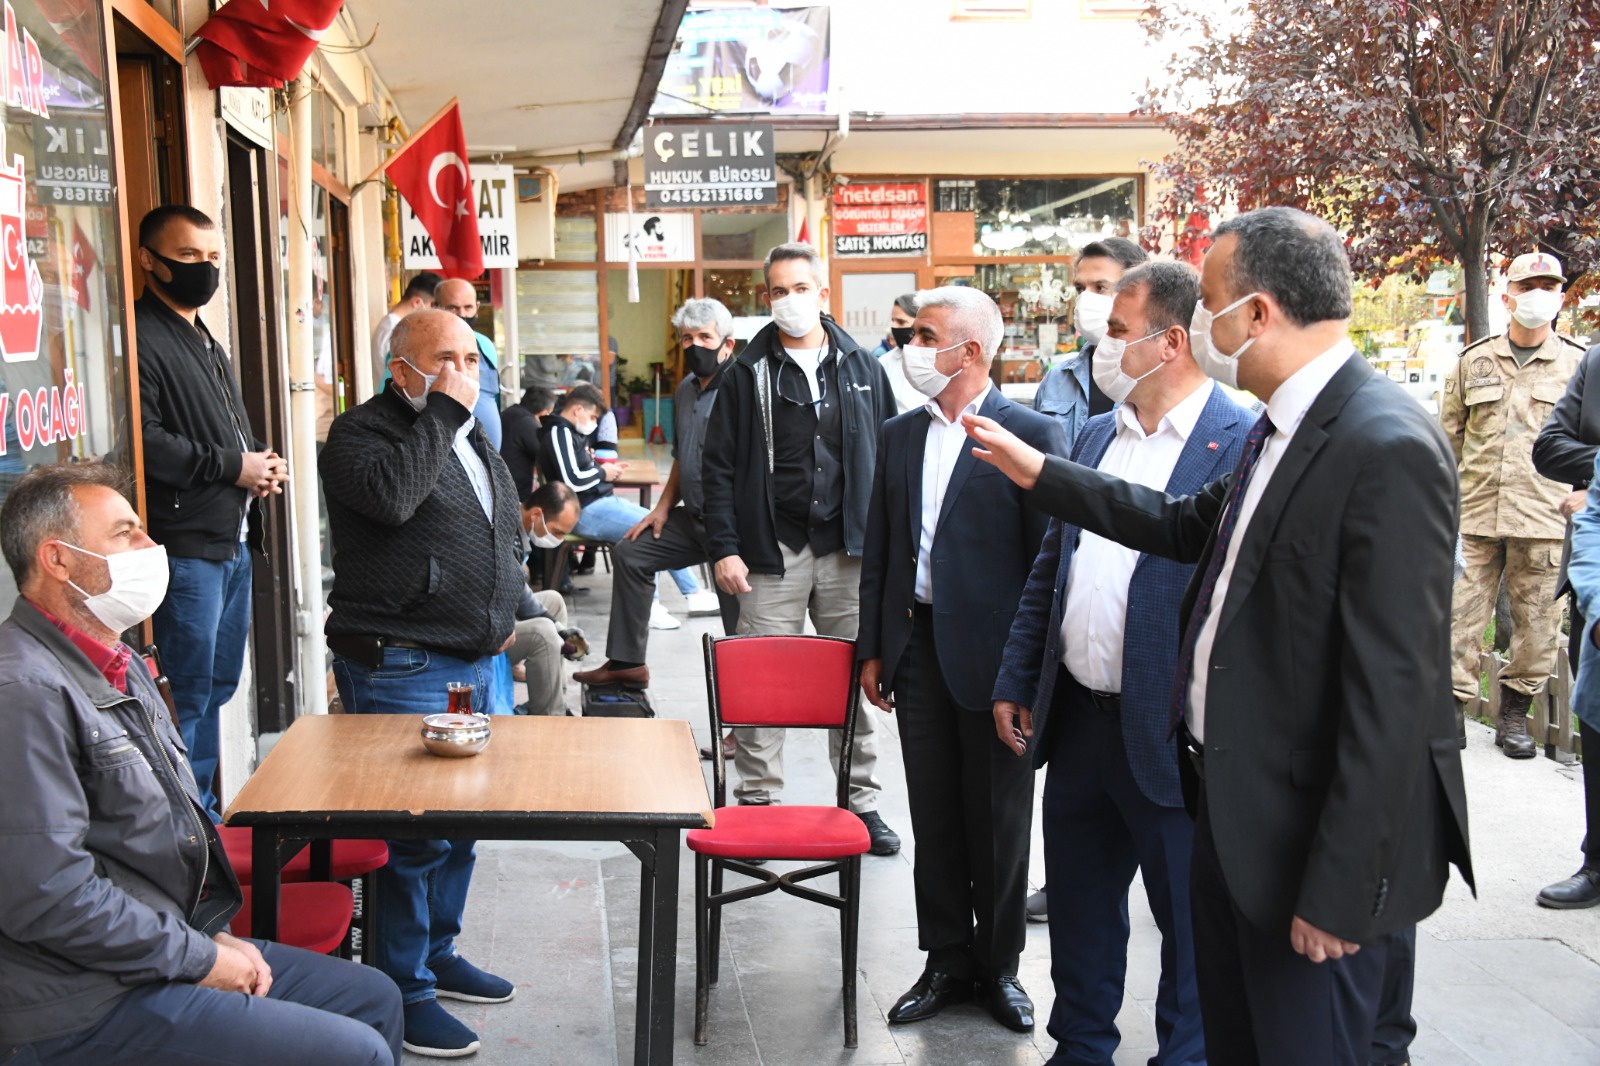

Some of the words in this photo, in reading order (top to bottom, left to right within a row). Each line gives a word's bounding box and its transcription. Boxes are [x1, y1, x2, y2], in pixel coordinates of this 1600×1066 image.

[0, 0, 50, 119] AR
[654, 130, 764, 163] ÇELİK
[650, 169, 703, 184] HUKUK
[709, 165, 771, 183] BÜROSU
[660, 187, 764, 202] 04562131686
[837, 236, 870, 254] SATIŞ
[873, 234, 925, 250] NOKTASI
[16, 368, 86, 451] OCAĞI
